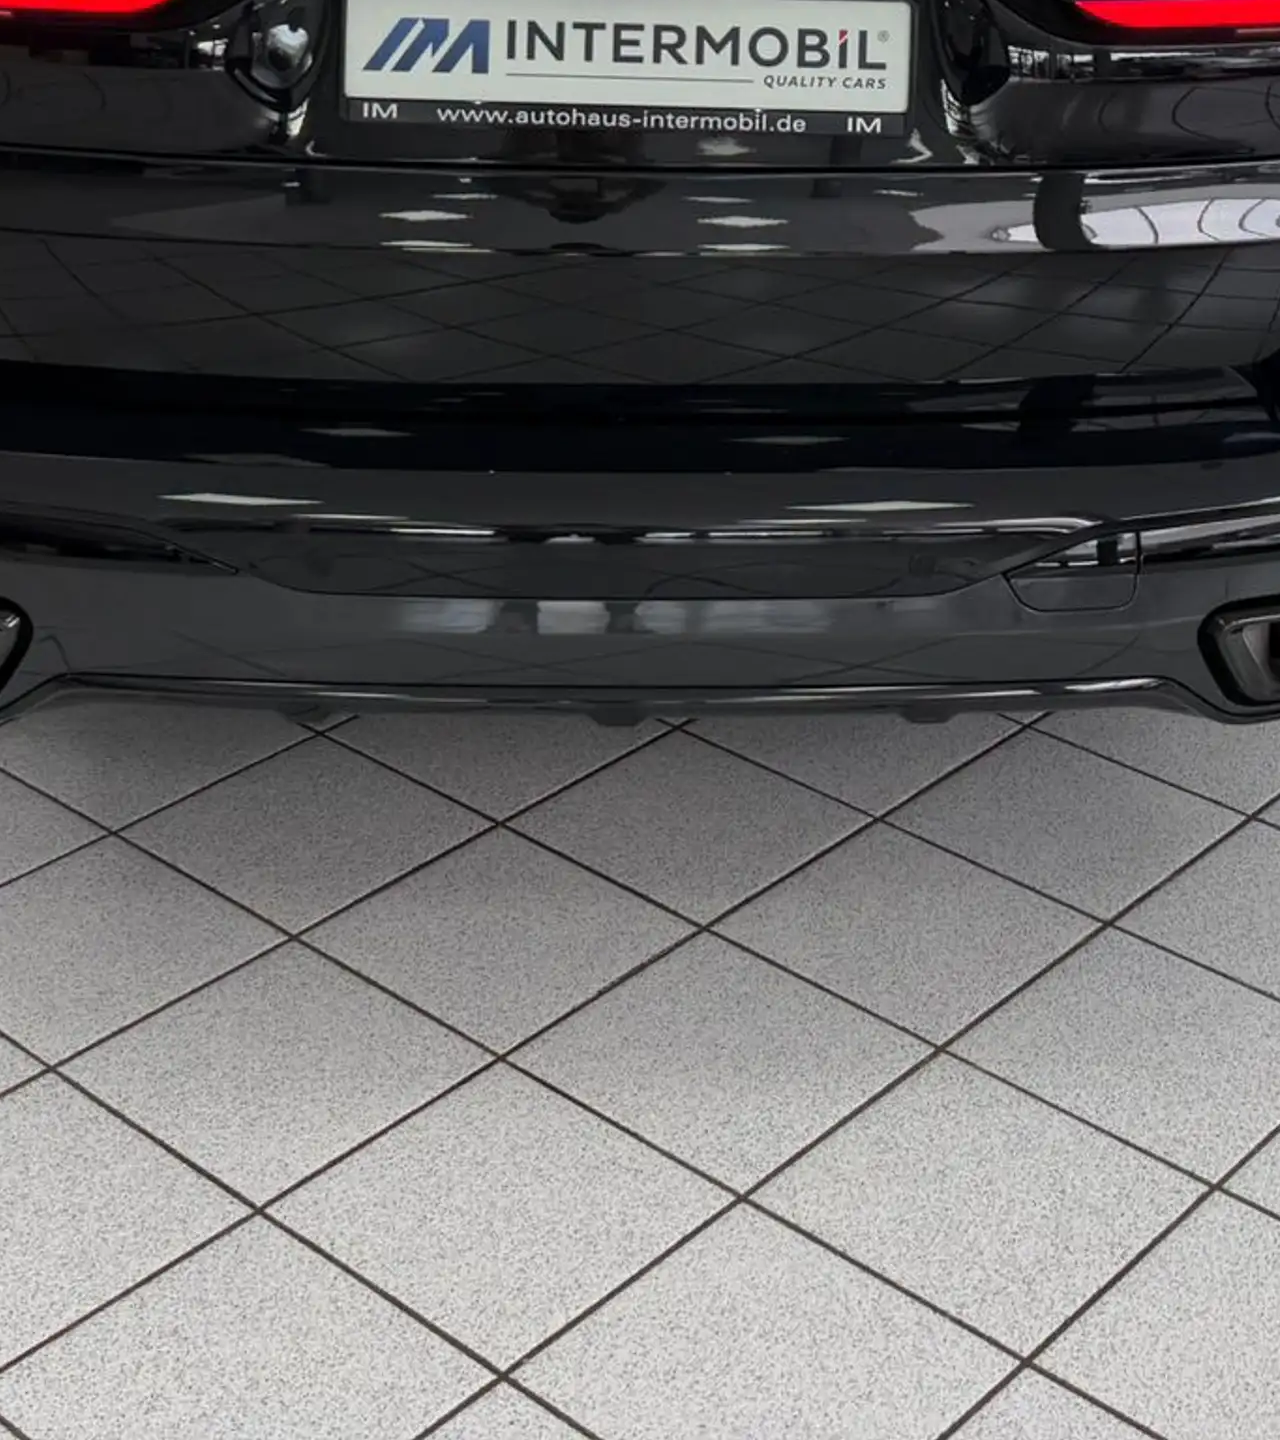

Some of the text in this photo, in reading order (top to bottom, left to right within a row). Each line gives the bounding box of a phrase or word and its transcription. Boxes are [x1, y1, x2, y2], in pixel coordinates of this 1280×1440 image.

[763, 74, 887, 90] QUALITY CARS
[363, 102, 398, 119] IM
[436, 105, 807, 133] www.autohaus-intermobil.de
[847, 116, 882, 133] IM
